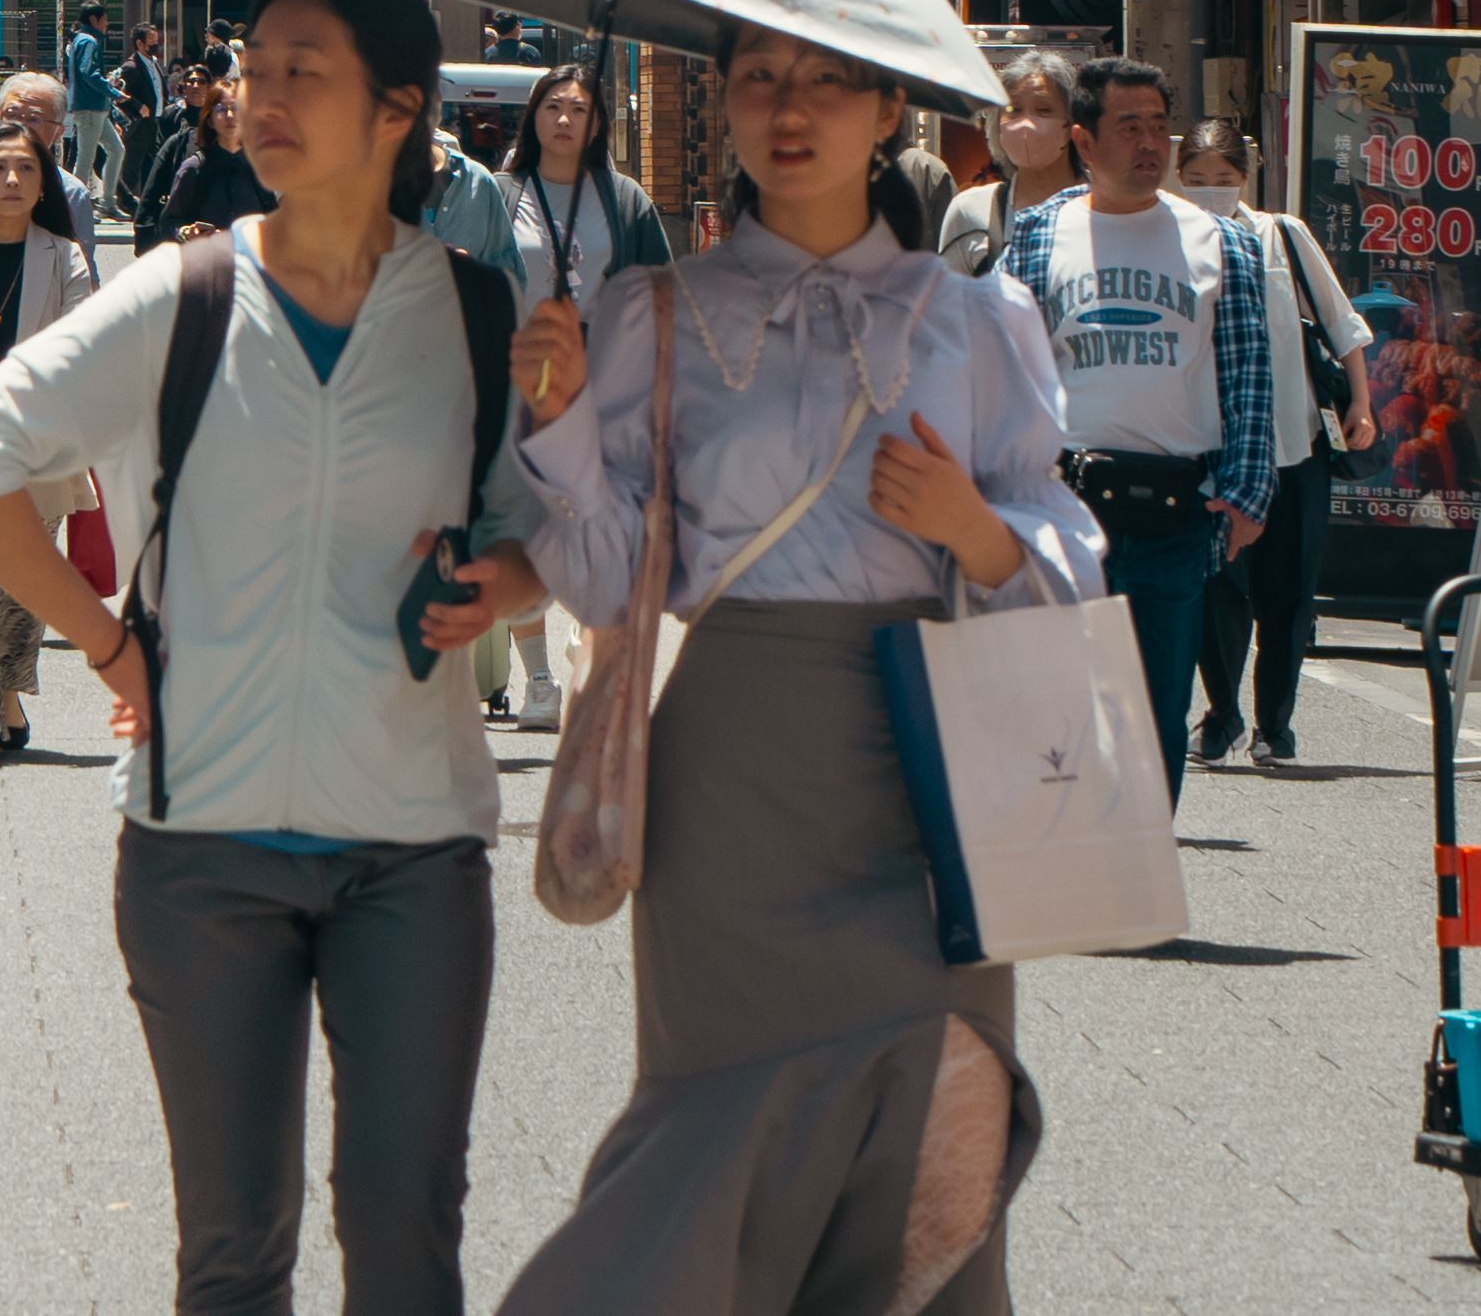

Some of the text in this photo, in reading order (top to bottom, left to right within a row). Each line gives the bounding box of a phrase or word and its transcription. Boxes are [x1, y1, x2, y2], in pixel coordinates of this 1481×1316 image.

[1390, 81, 1446, 94] NANIWA
[1360, 135, 1476, 191] 100
[1359, 204, 1475, 257] 280
[1044, 268, 1195, 324] MICHIGAN
[1070, 331, 1179, 370] MIDWEST
